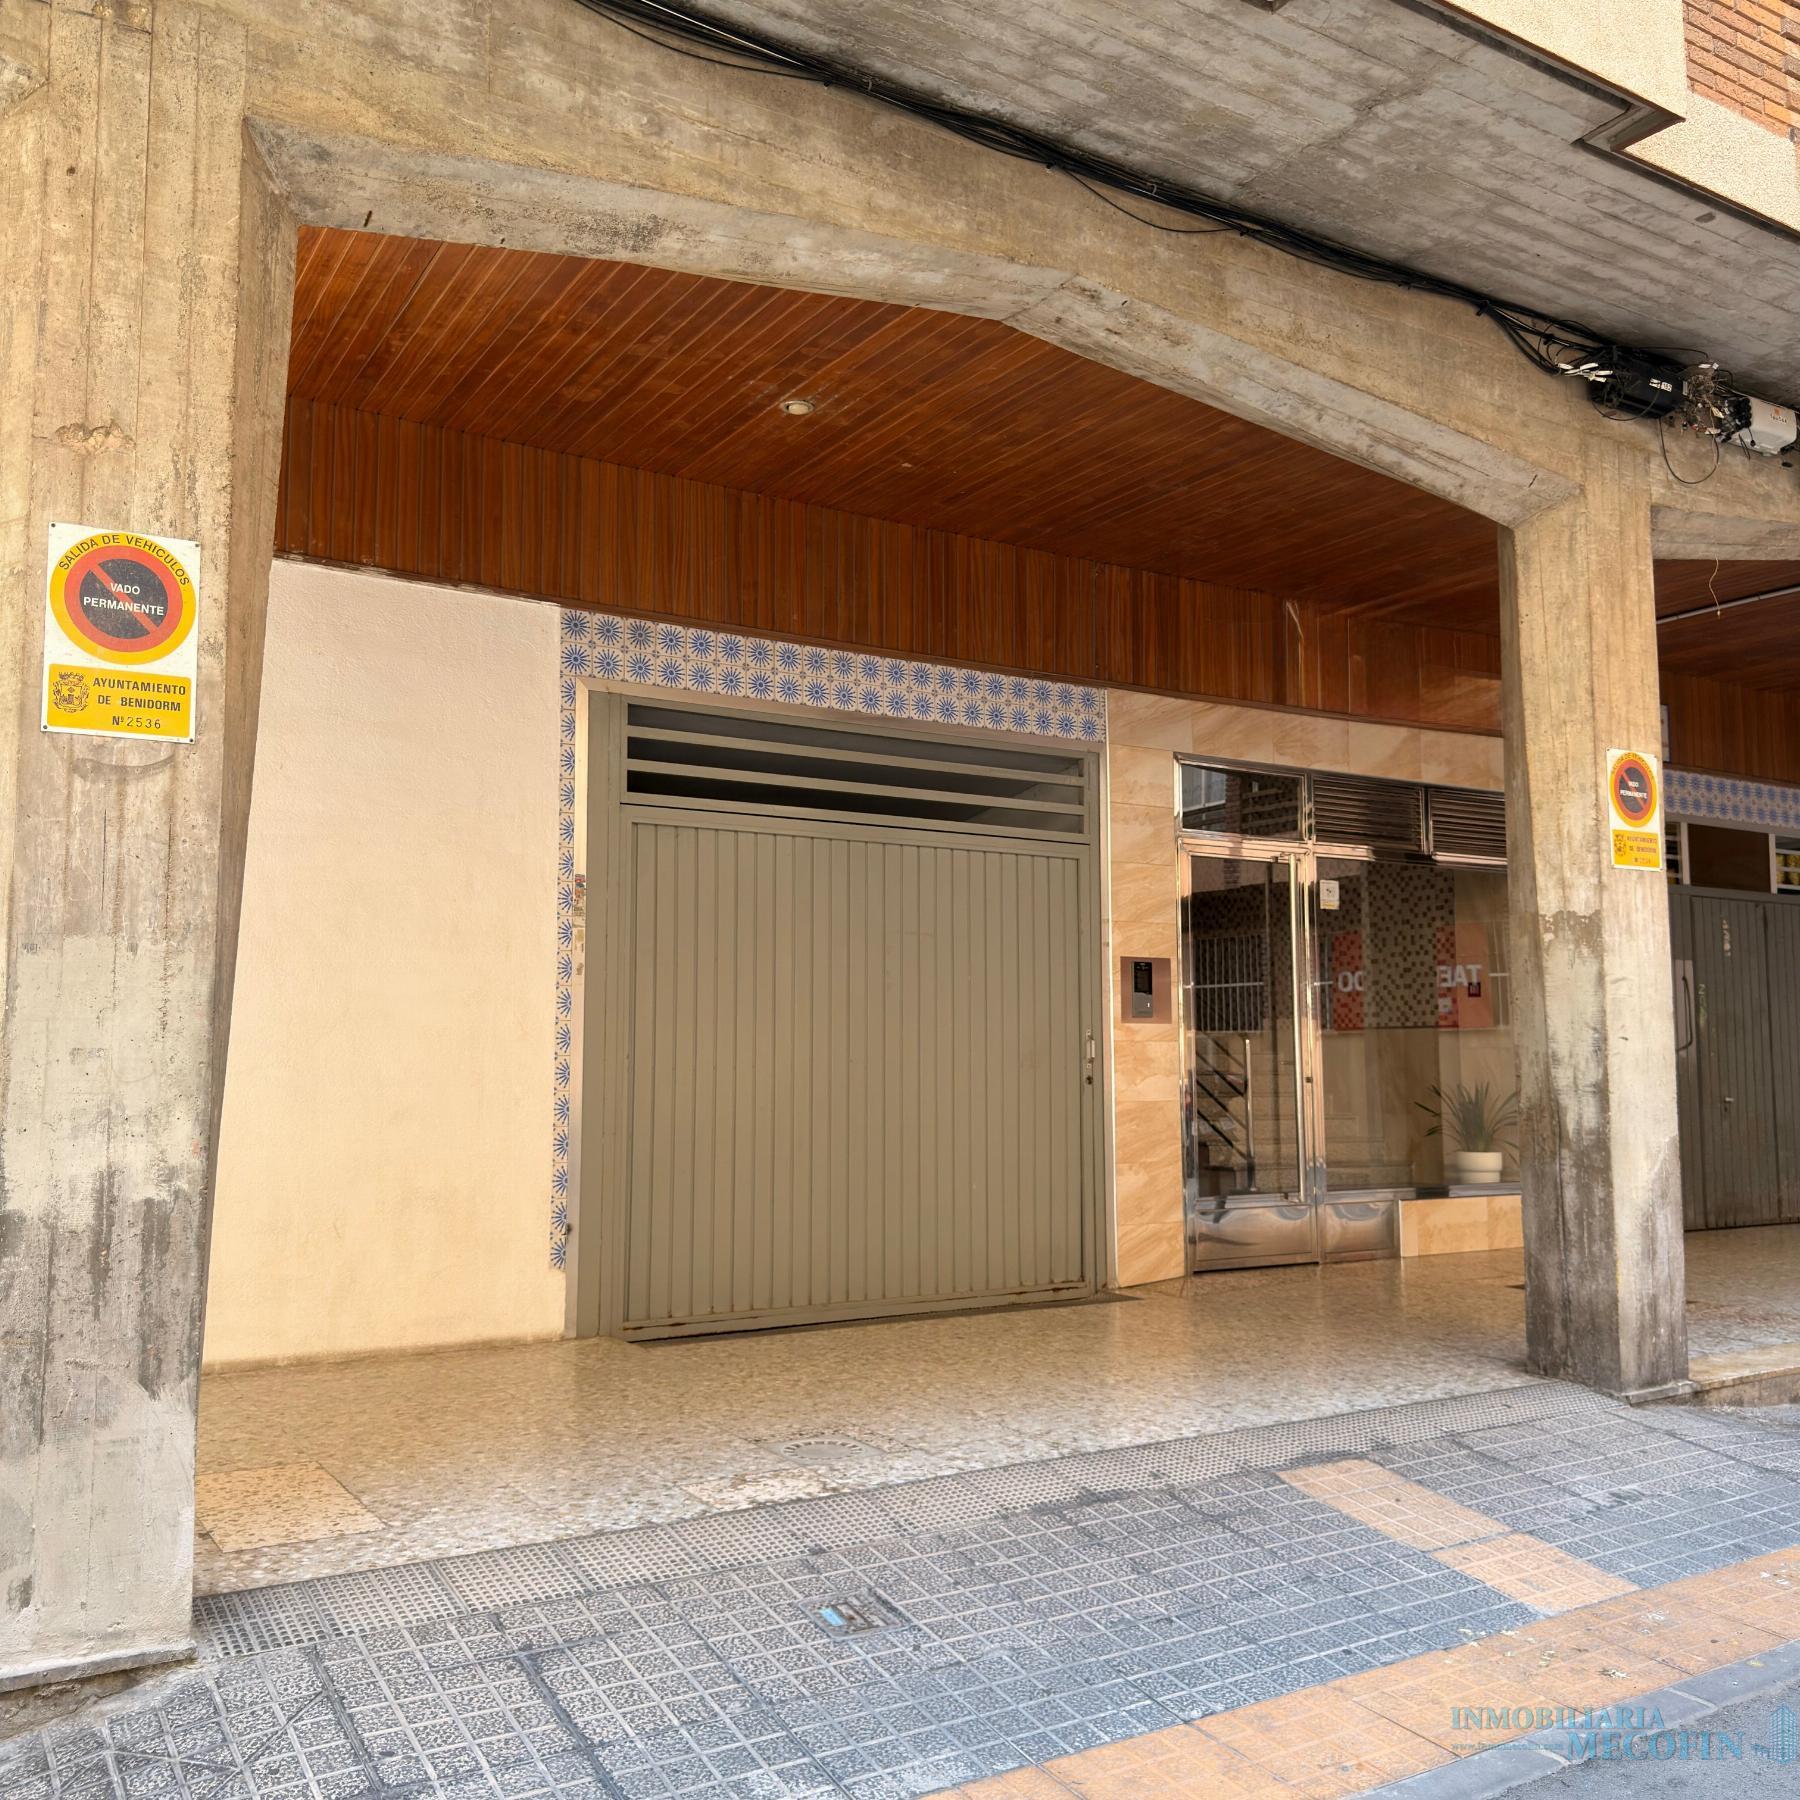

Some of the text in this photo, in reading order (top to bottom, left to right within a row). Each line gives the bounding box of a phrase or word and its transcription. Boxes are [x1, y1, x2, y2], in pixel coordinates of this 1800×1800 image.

[58, 534, 190, 586] SALIDA DE VEHICULOS
[110, 582, 141, 595] VADO
[83, 596, 165, 616] PERMANENTE
[92, 677, 187, 696] AYUNTAMIENTO
[97, 695, 181, 712] DE BENIDORM
